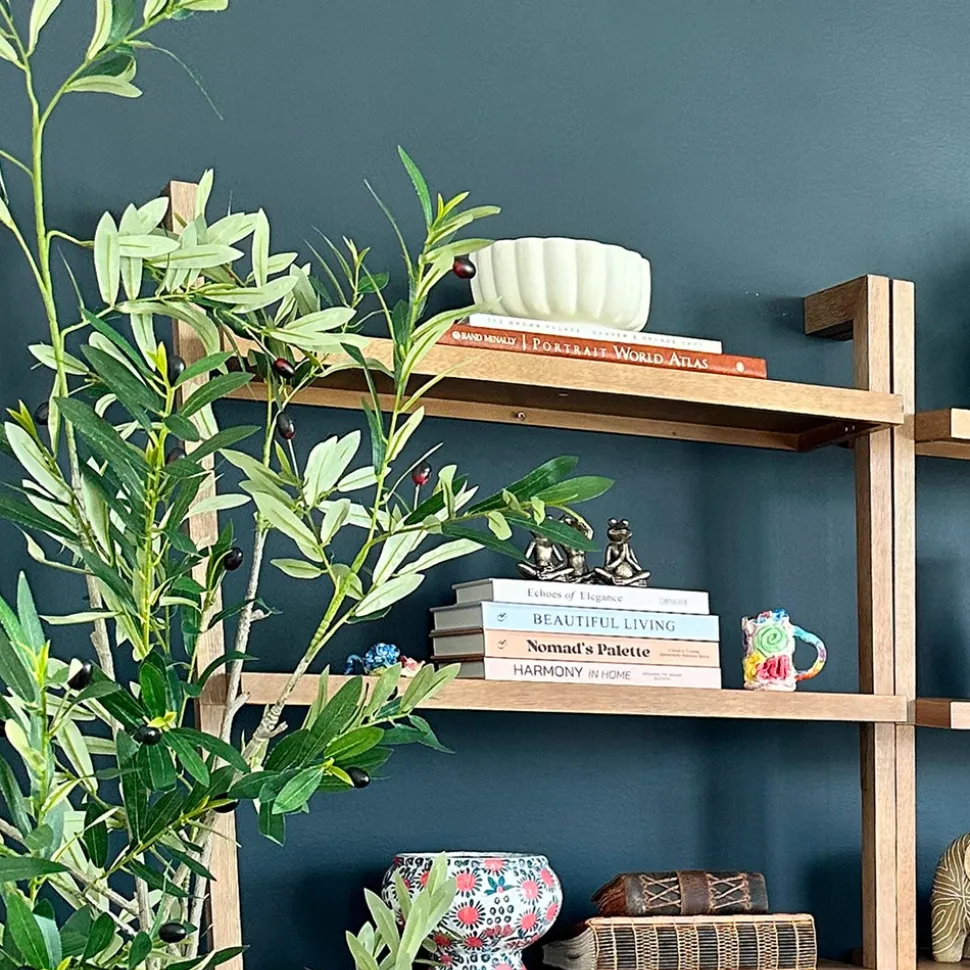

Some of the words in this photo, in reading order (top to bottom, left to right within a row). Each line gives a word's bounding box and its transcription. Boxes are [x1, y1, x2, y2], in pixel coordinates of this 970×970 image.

[461, 331, 483, 342] RAND
[532, 337, 608, 358] PORTRAIT
[612, 344, 665, 365] WORLD
[668, 351, 709, 370] ATLAS
[527, 588, 562, 598] Echoes
[564, 590, 576, 601] of
[580, 591, 624, 603] Elegance
[533, 613, 620, 629] BEAUTIFUL
[624, 618, 676, 632] LIVING
[526, 639, 594, 656] Nomad's
[597, 643, 651, 658] Palette
[513, 664, 584, 678] HARMONY
[587, 669, 599, 679] IN
[601, 670, 632, 681] HOME
